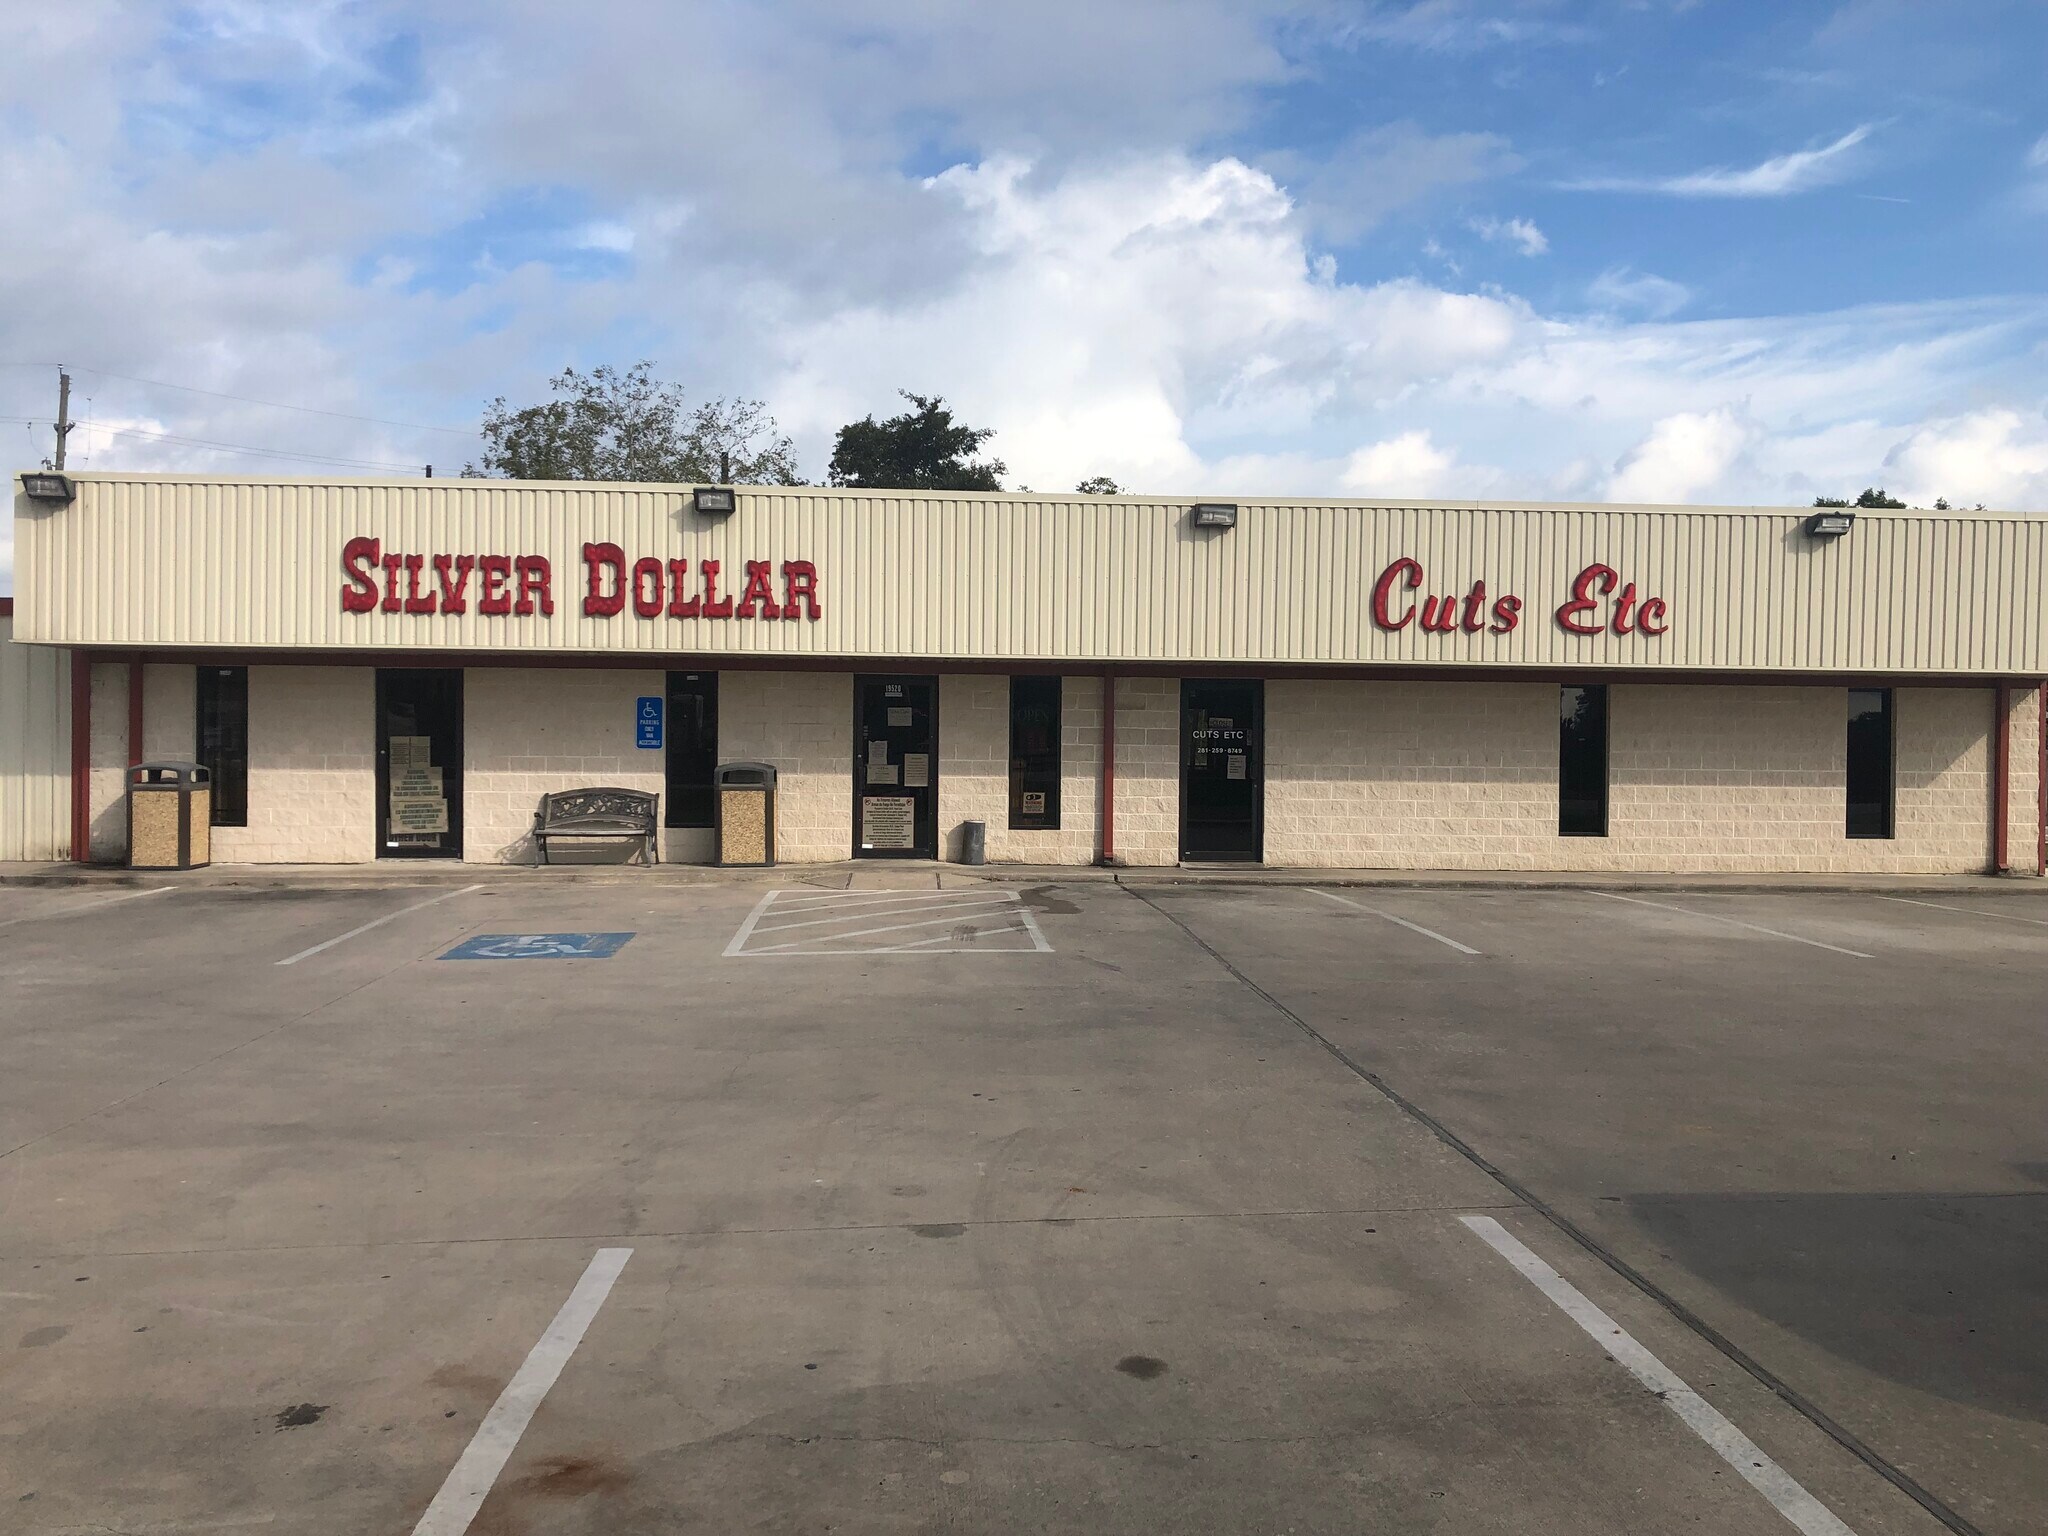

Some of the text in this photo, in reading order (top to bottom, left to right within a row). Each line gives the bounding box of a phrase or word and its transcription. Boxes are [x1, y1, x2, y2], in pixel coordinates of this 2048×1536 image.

[342, 536, 822, 620] SILVER DOLLAR
[1373, 556, 1669, 634] Cuts Etc
[885, 684, 902, 692] 19520
[1192, 730, 1220, 739] CUTS
[1223, 731, 1244, 739] ETC
